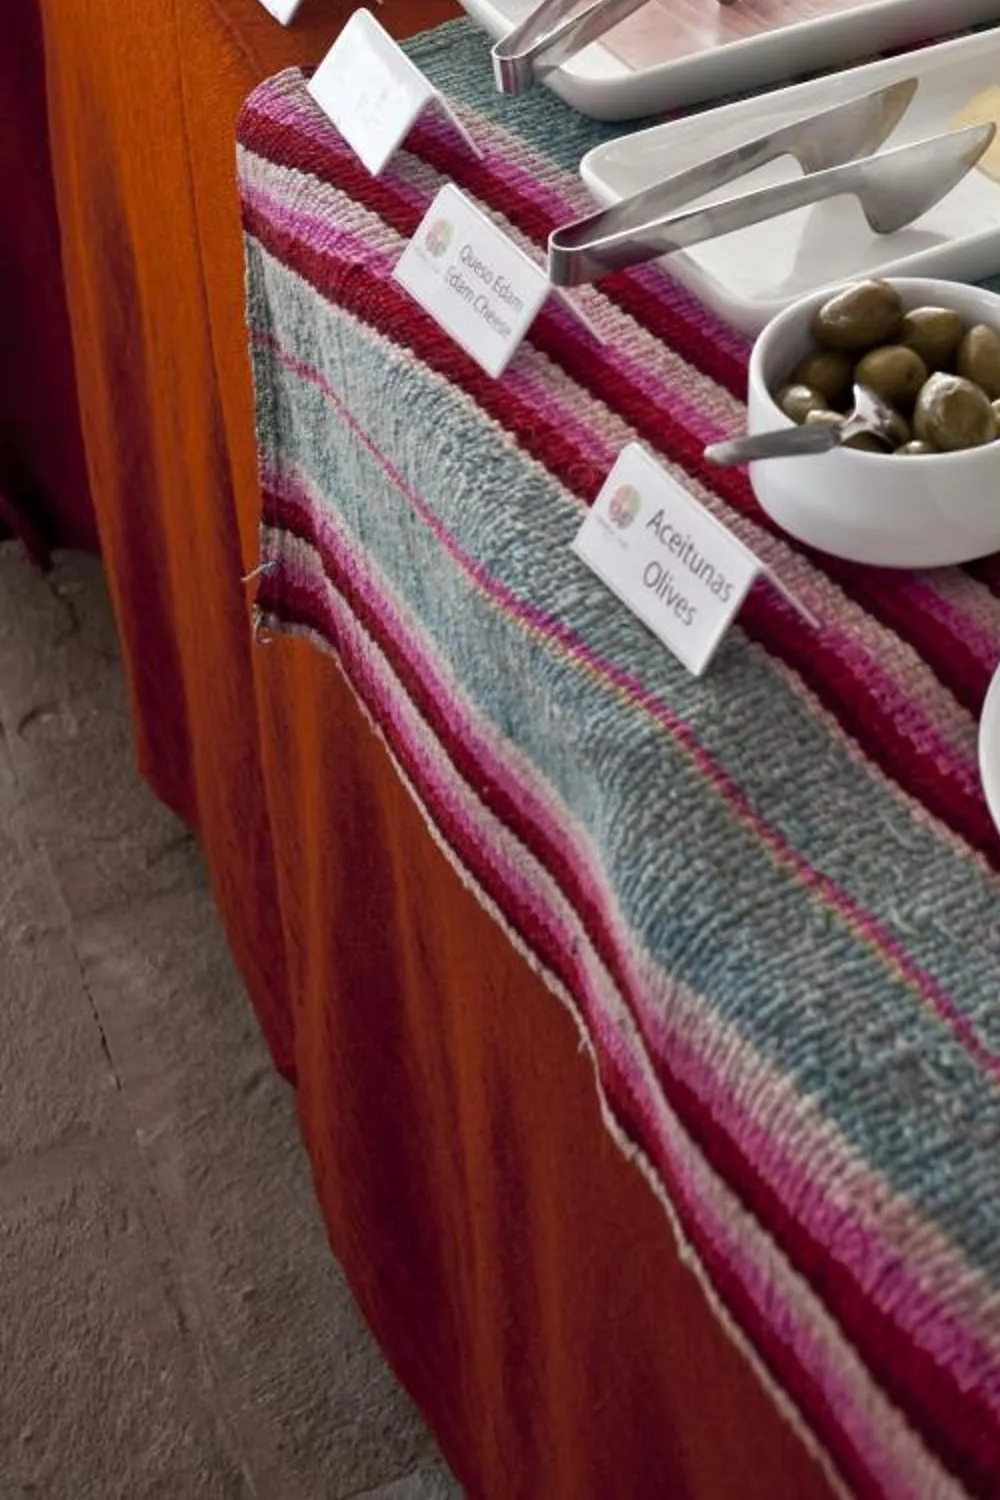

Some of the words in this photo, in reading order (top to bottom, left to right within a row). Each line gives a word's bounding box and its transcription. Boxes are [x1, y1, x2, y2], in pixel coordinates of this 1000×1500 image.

[459, 243, 495, 284] Queso
[492, 275, 524, 311] Edam
[646, 508, 735, 603] Aceitunas
[642, 560, 697, 626] Olives
